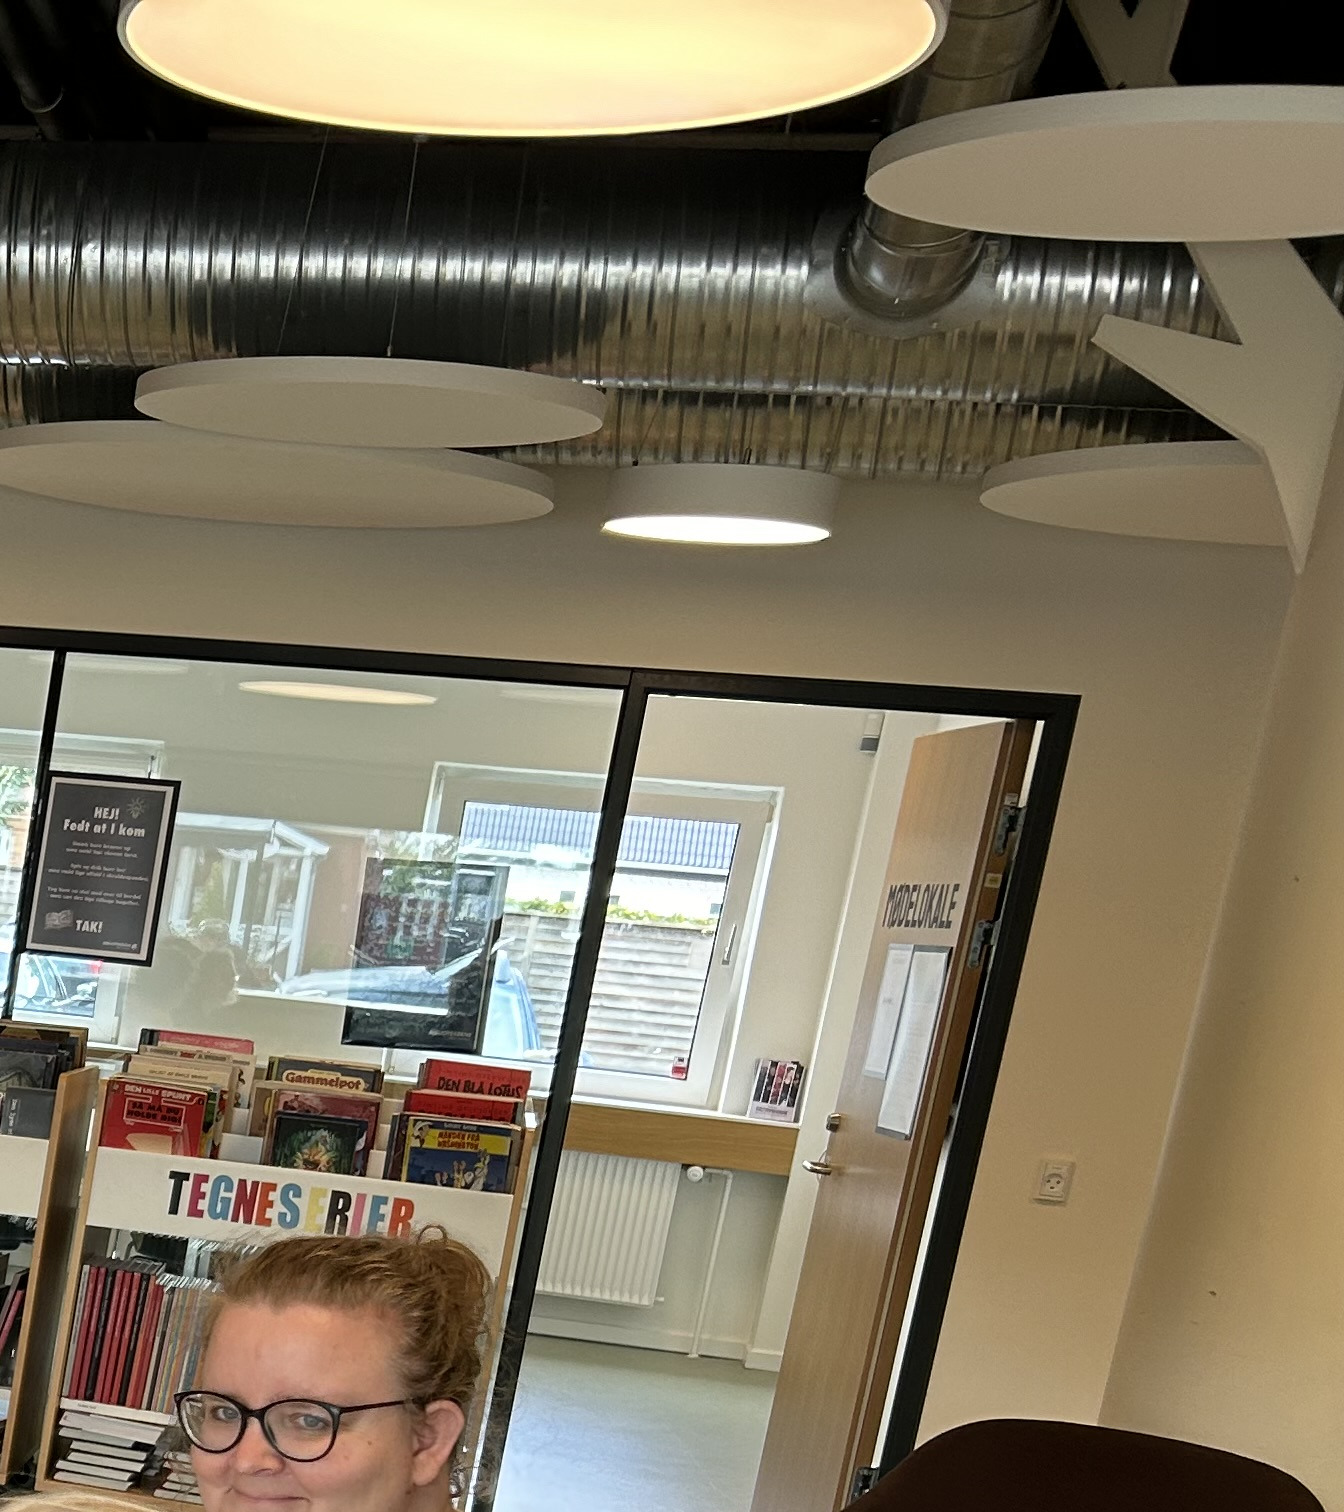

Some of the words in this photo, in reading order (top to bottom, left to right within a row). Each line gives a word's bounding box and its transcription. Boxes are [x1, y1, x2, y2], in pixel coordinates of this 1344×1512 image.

[93, 805, 120, 821] HEJ!
[62, 818, 91, 834] Fedt
[93, 822, 107, 835] at
[110, 822, 115, 836] I
[118, 824, 146, 838] kom
[882, 883, 961, 930] MØDELOKALE
[75, 919, 104, 934] TAK!
[124, 1083, 142, 1094] DEN
[284, 1071, 363, 1092] Gammelpot
[437, 1076, 460, 1092] DEN
[488, 1083, 523, 1099] LOTUS
[466, 1133, 481, 1143] FRA
[167, 1170, 415, 1239] TEGNESERIER
